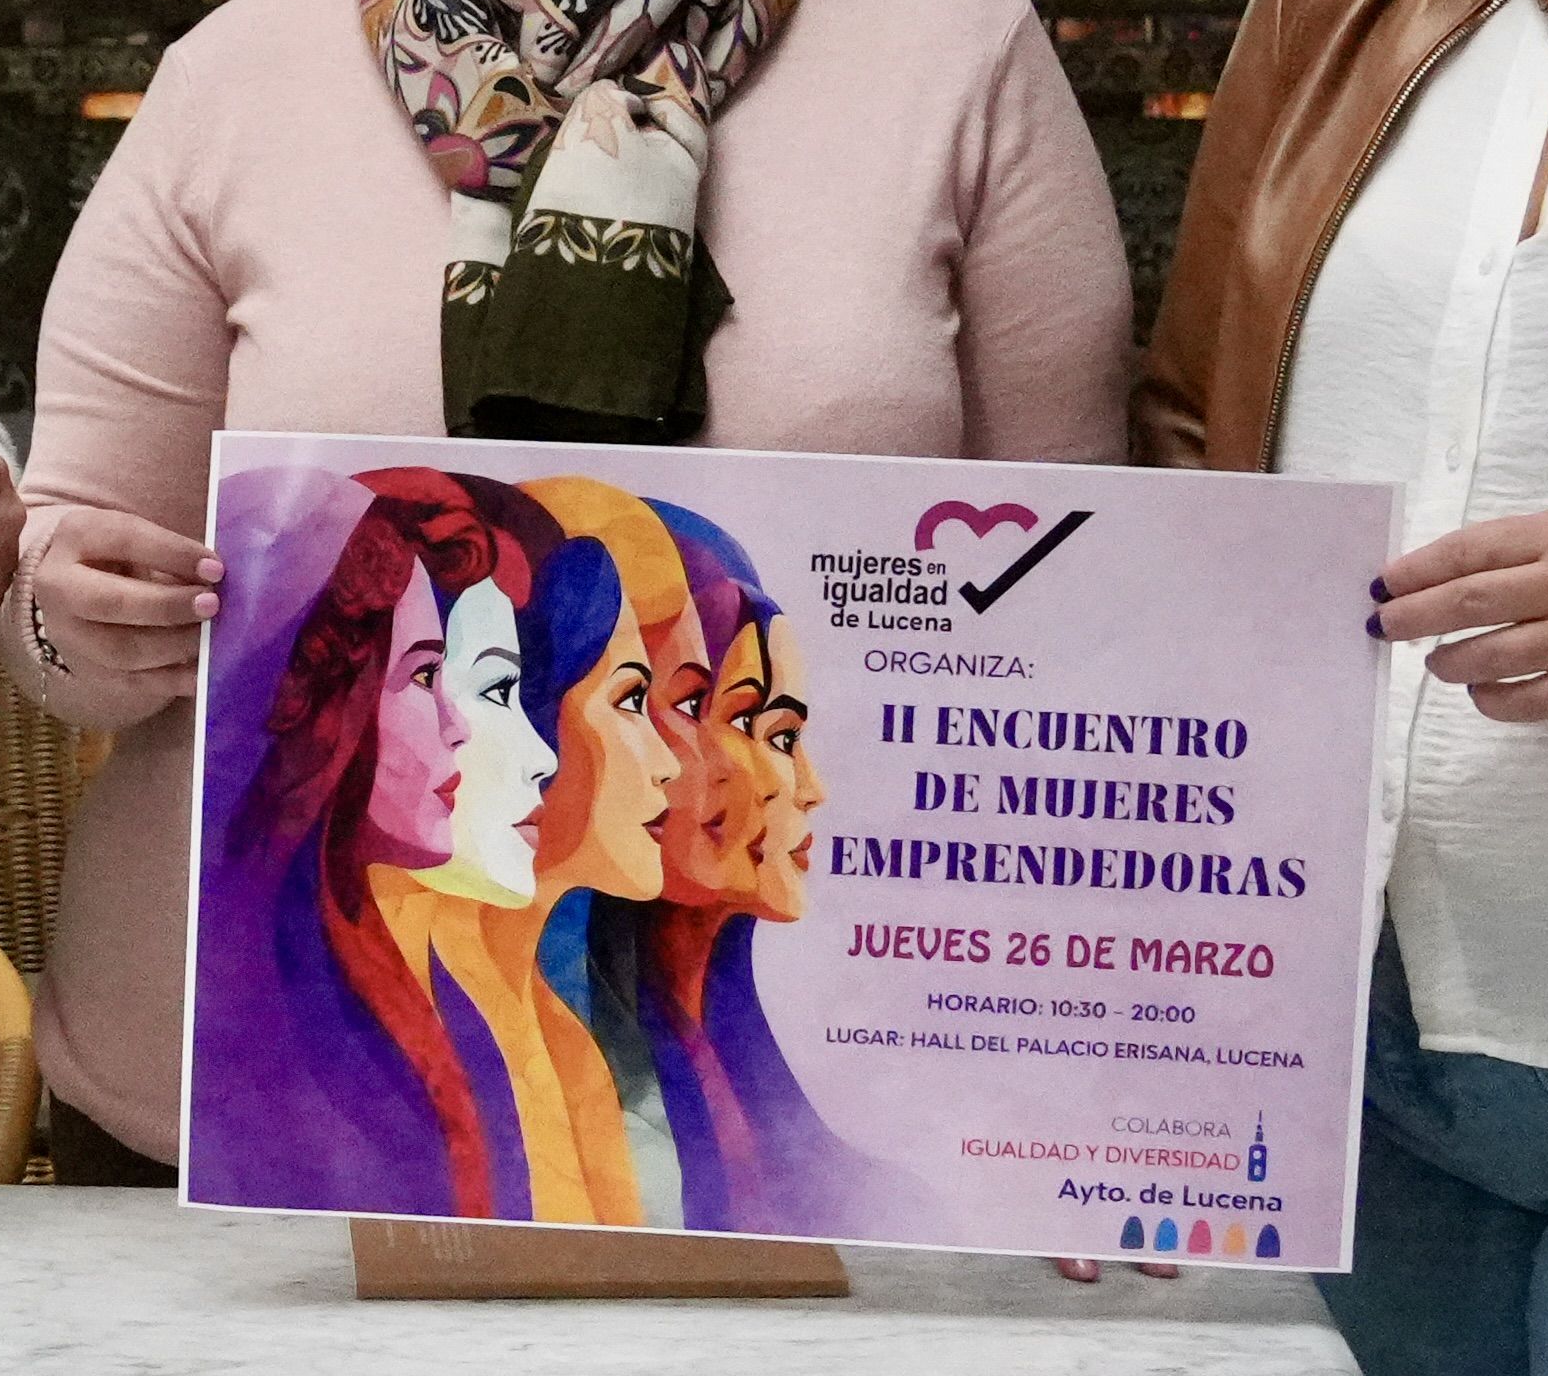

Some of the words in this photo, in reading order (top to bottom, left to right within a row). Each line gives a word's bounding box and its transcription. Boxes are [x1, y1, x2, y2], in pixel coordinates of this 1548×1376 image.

[811, 550, 922, 580] mujeres
[927, 563, 946, 574] en
[824, 575, 947, 608] igualdad
[831, 609, 859, 628] de
[869, 611, 952, 632] Lucena
[865, 650, 1033, 678] ORGANIZA:
[882, 704, 915, 743] II
[937, 707, 1247, 758] ENCUENTRO
[915, 772, 979, 812] DE
[998, 776, 1234, 824] MUJERES
[831, 836, 1305, 897] EMPRENDEDORAS
[848, 924, 990, 963] JUEVES
[1006, 932, 1050, 967] 26
[1067, 935, 1115, 969] DE
[1130, 938, 1274, 978] MARZO
[928, 994, 1043, 1015] HORARIO:
[1051, 1000, 1106, 1018] 10:30
[1131, 1004, 1195, 1023] 20:00
[827, 1028, 904, 1046] LUGAR:
[911, 1032, 964, 1050] HALL
[972, 1035, 1009, 1052] DEL
[1017, 1038, 1108, 1057] PALACIO
[1115, 1042, 1210, 1064] ERISANA,
[1216, 1048, 1304, 1068] LUCENA
[1112, 1118, 1231, 1138] COLABORA
[962, 1139, 1080, 1161] IGUALDAD
[1086, 1145, 1098, 1161] Y
[1106, 1146, 1240, 1171] DIVERSIDAD
[1058, 1179, 1130, 1205] Ayto.
[1140, 1183, 1173, 1204] de
[1183, 1186, 1282, 1211] Lucena
